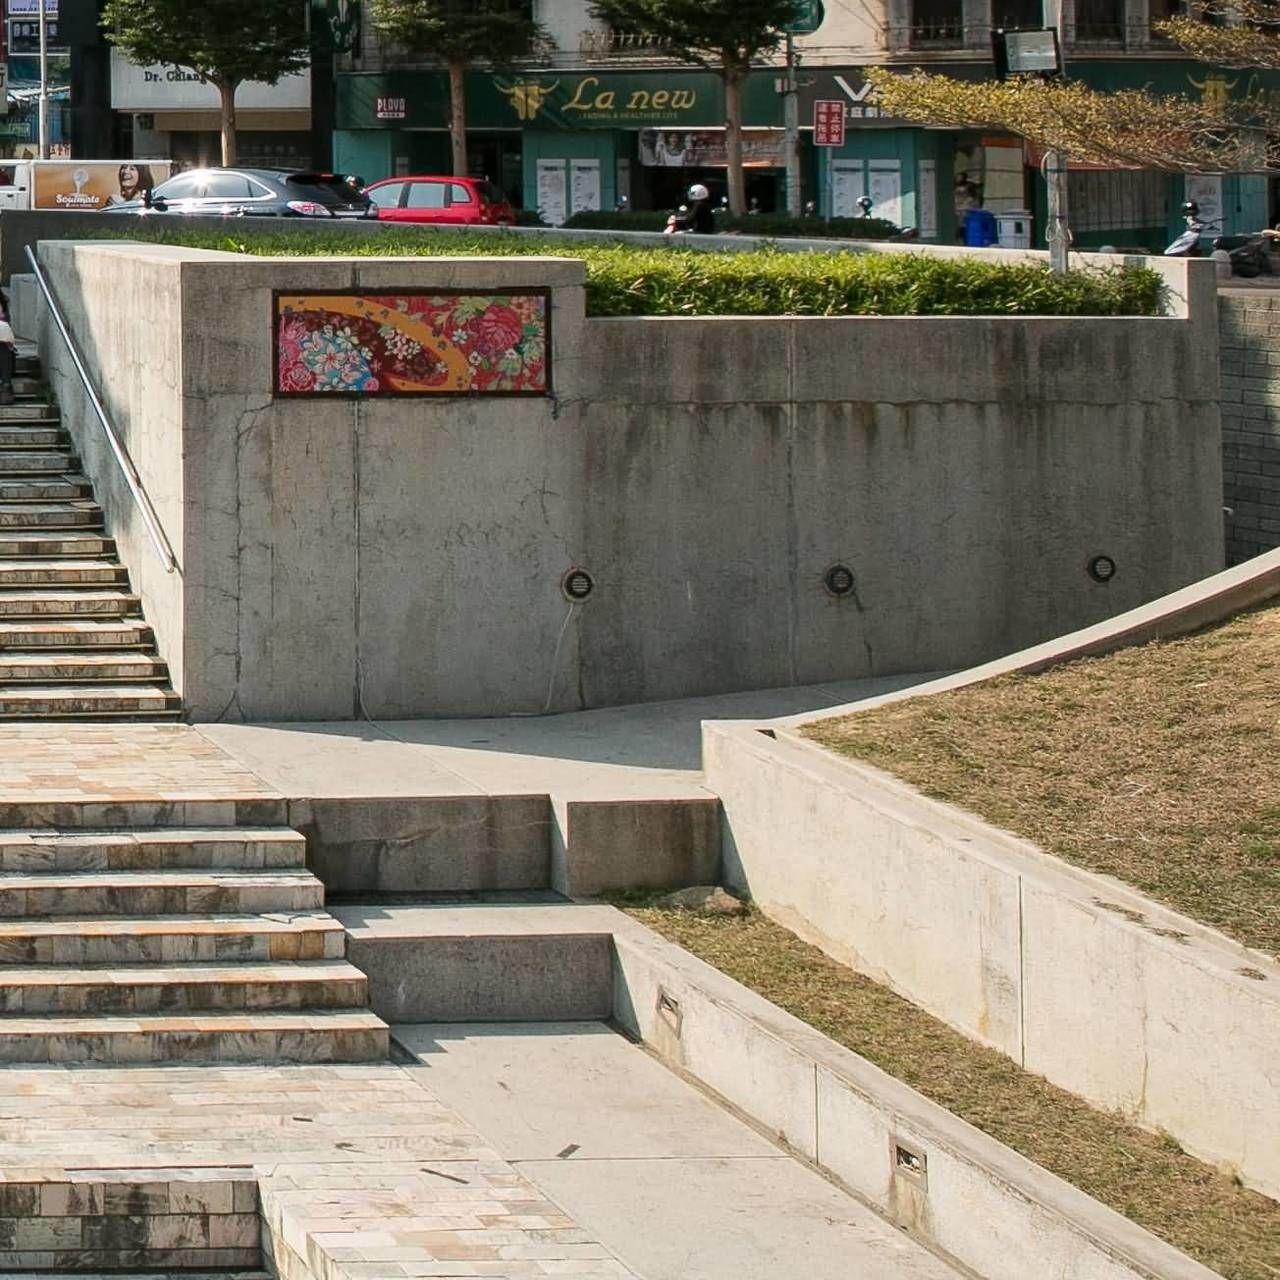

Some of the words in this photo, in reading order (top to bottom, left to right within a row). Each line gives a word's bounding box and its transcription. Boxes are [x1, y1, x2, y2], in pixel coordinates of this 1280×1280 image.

[144, 71, 163, 82] Dr.
[561, 77, 616, 111] La
[626, 89, 696, 110] new
